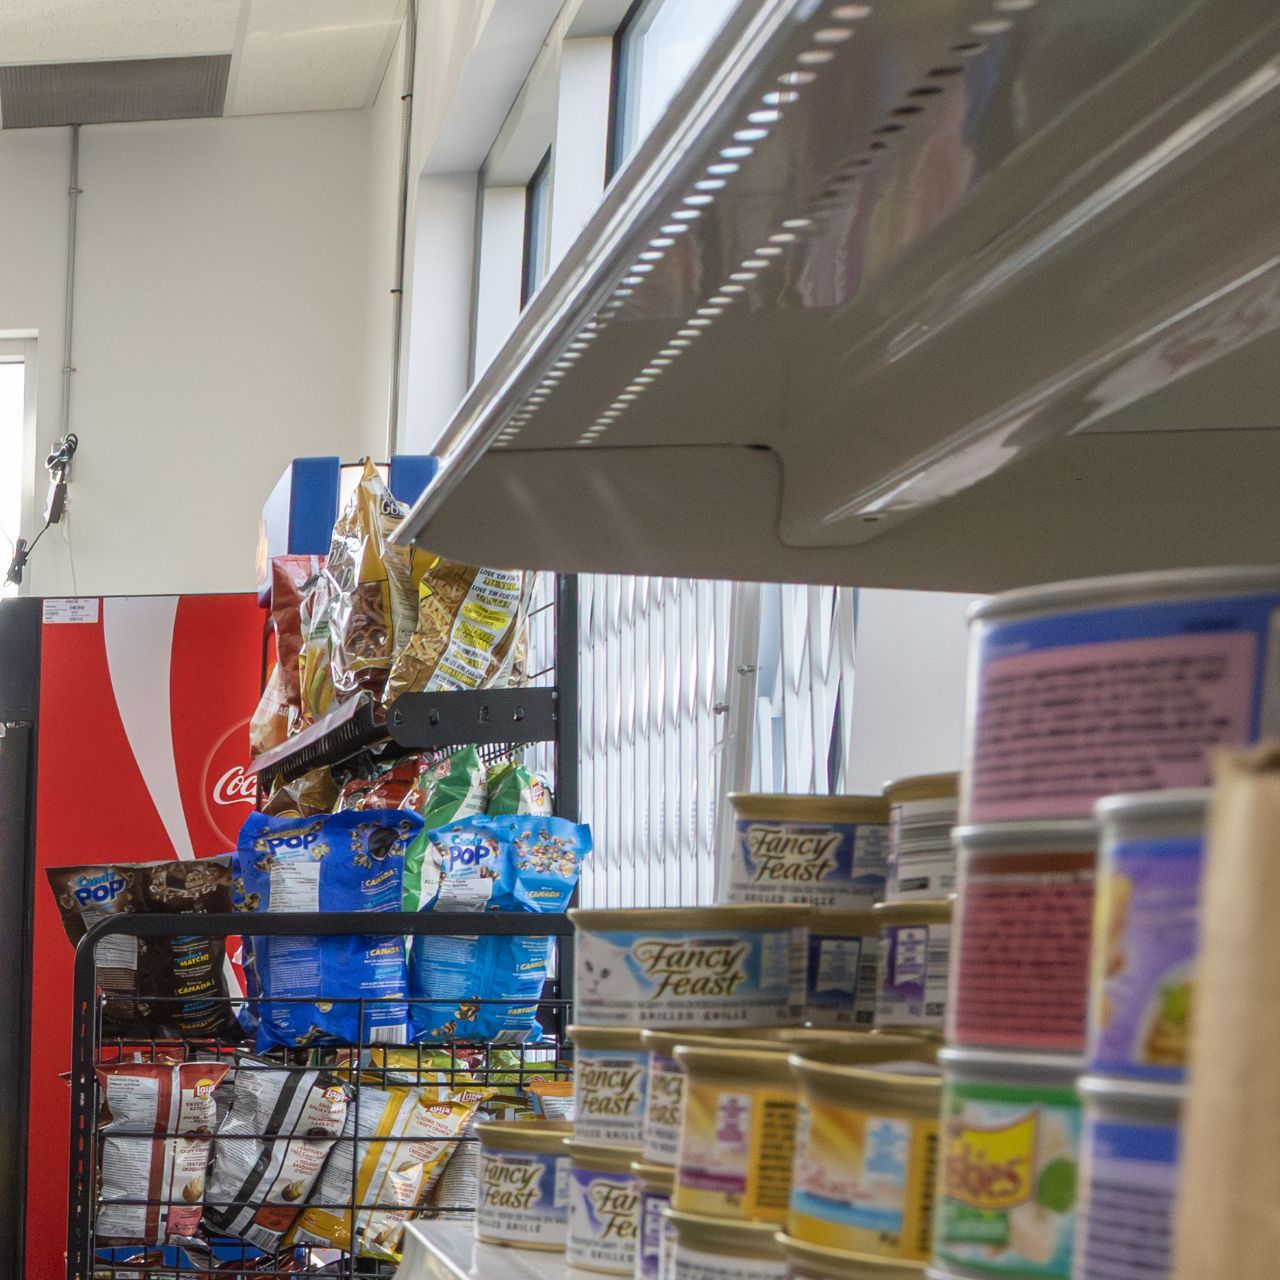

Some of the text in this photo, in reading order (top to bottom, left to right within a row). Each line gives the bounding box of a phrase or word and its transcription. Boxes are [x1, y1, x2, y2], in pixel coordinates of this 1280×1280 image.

[212, 765, 260, 806] Coc
[268, 833, 317, 851] POP
[751, 828, 837, 862] Fancy
[450, 846, 489, 871] POP
[755, 857, 833, 883] Feast
[74, 880, 125, 906] POP
[637, 940, 746, 973] Fancy
[178, 981, 212, 995] CANADA
[654, 969, 743, 999] Feast
[579, 1060, 641, 1093] Fancy
[579, 1088, 639, 1115] Feast
[483, 1158, 540, 1188] Fancy
[483, 1184, 537, 1210] Feast
